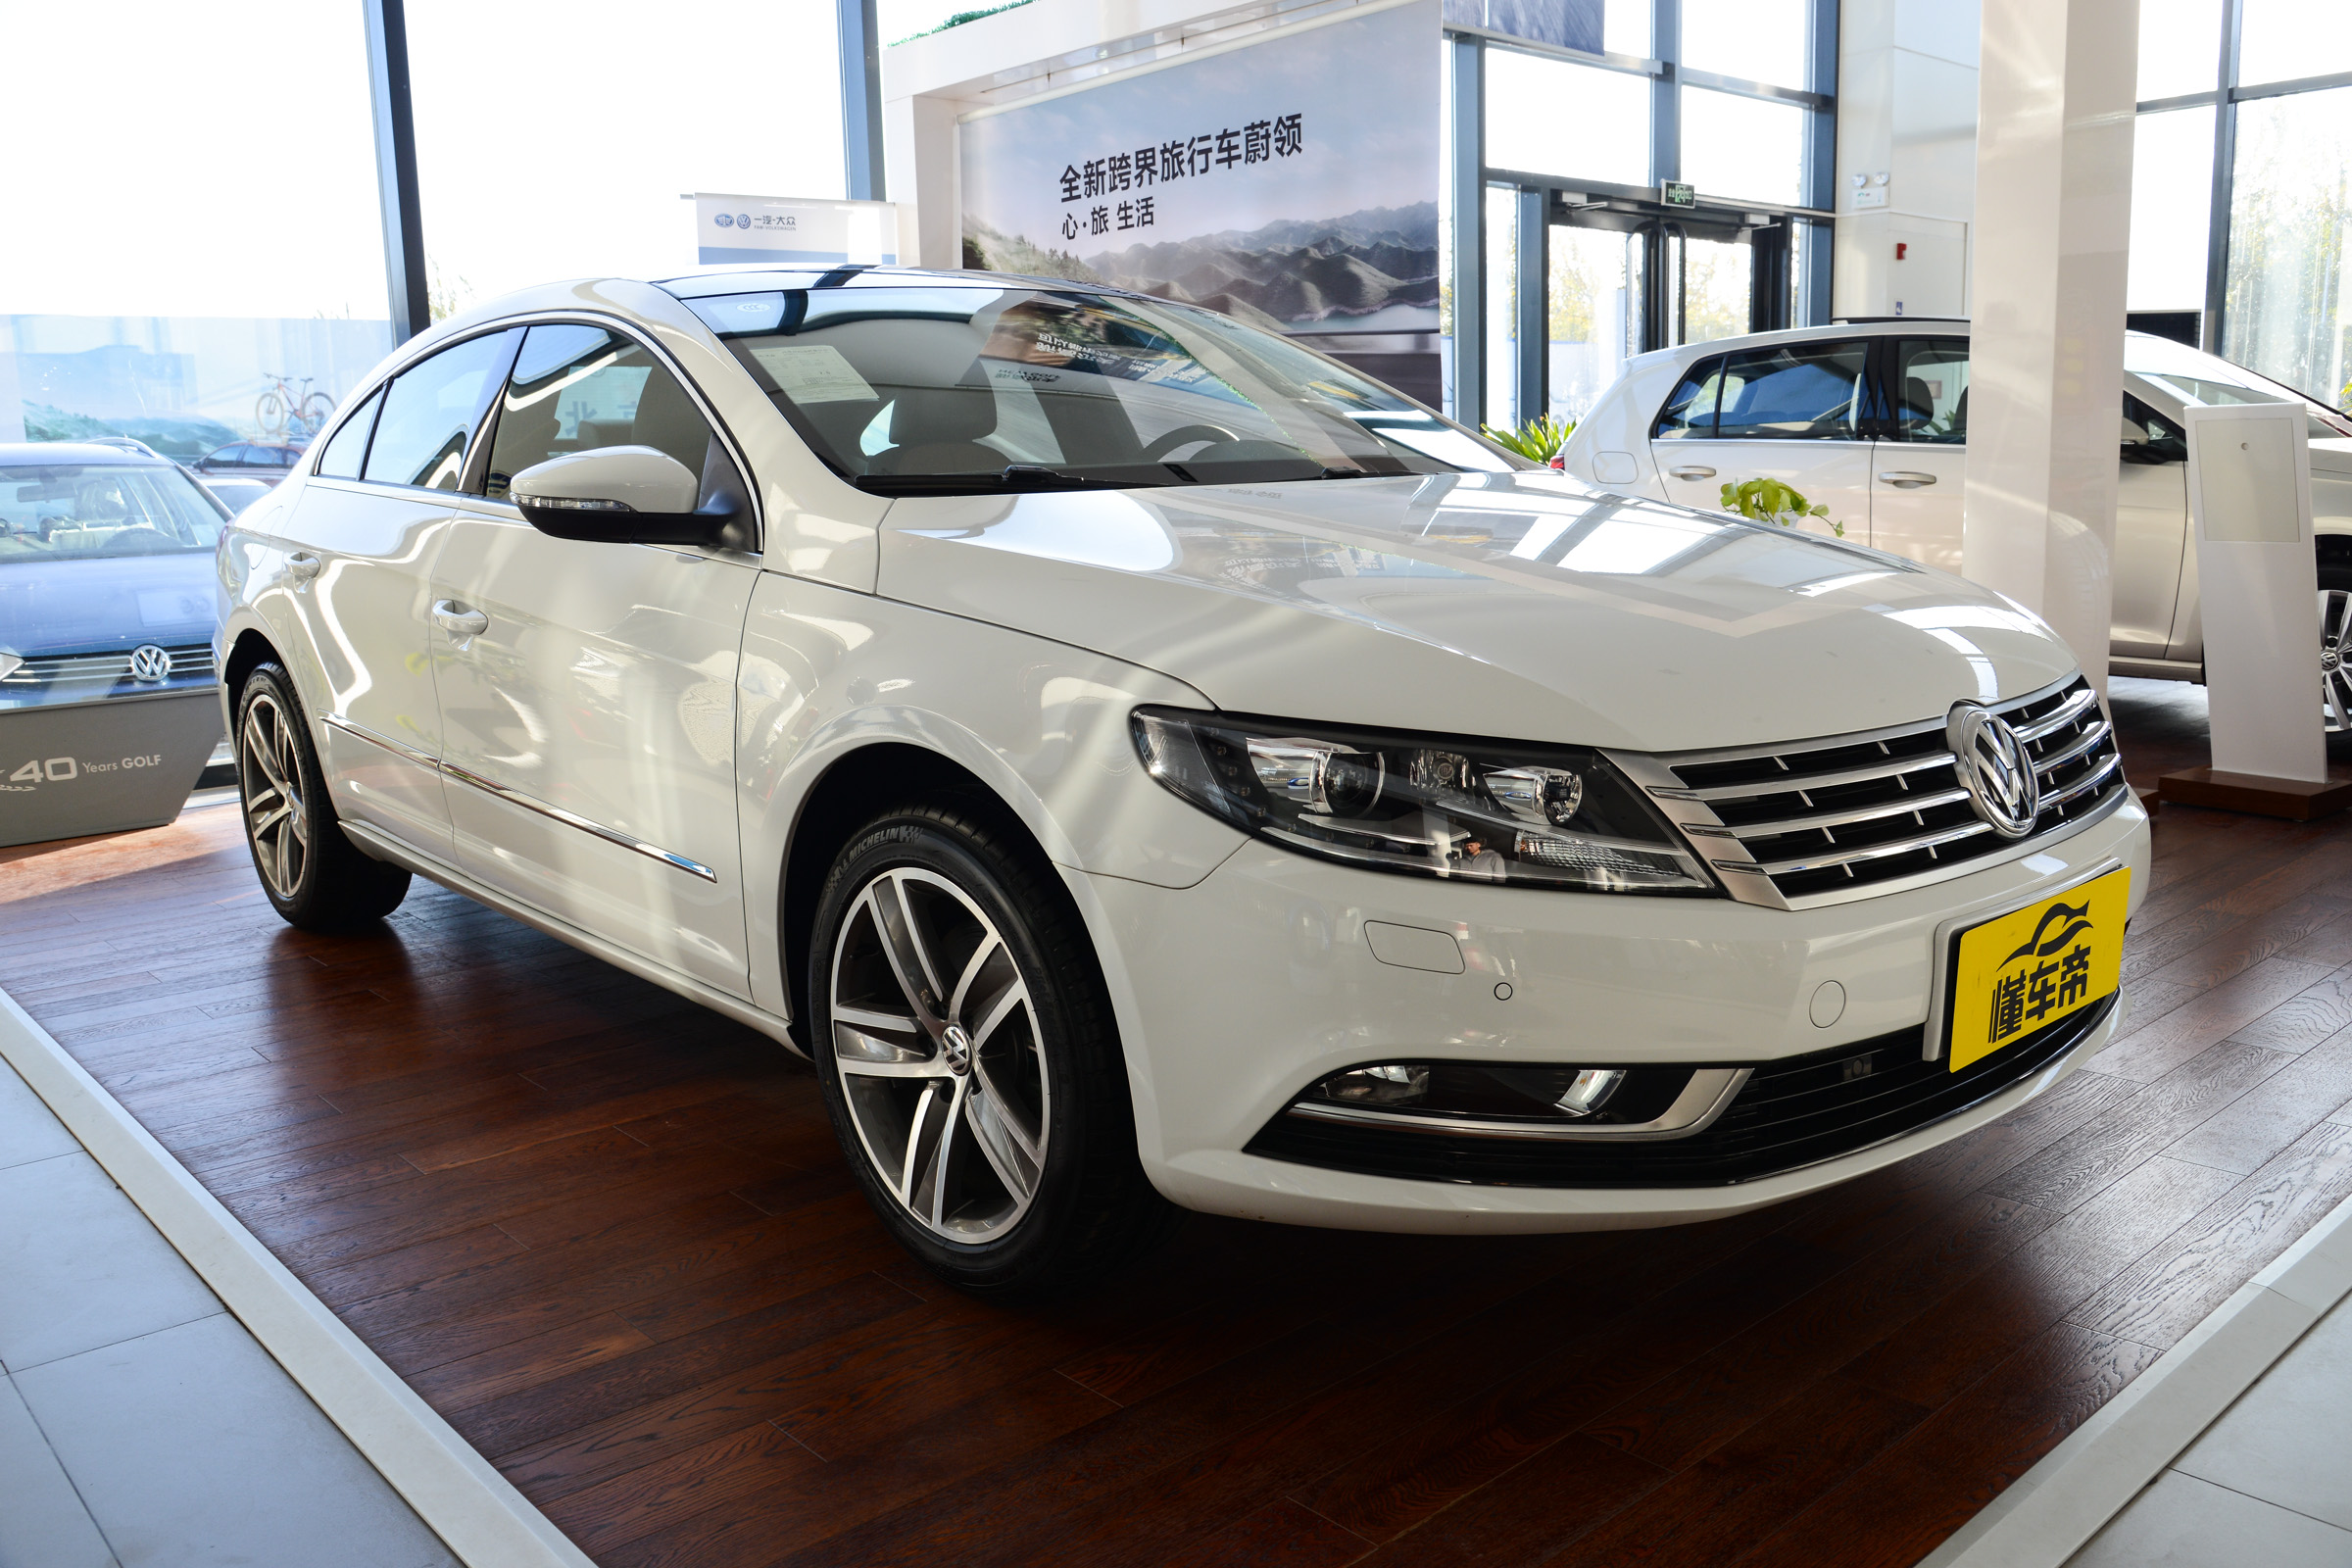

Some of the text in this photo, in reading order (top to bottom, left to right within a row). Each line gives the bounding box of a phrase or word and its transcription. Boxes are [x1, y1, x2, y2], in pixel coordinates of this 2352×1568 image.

[1059, 113, 1302, 203] 全新跨界旅行车蔚领
[1061, 196, 1154, 241] 心·旅 生活
[9, 754, 162, 783] 40 Years GOLF
[849, 827, 900, 860] MICHELIN
[1987, 944, 2091, 1044] 懂车帝
